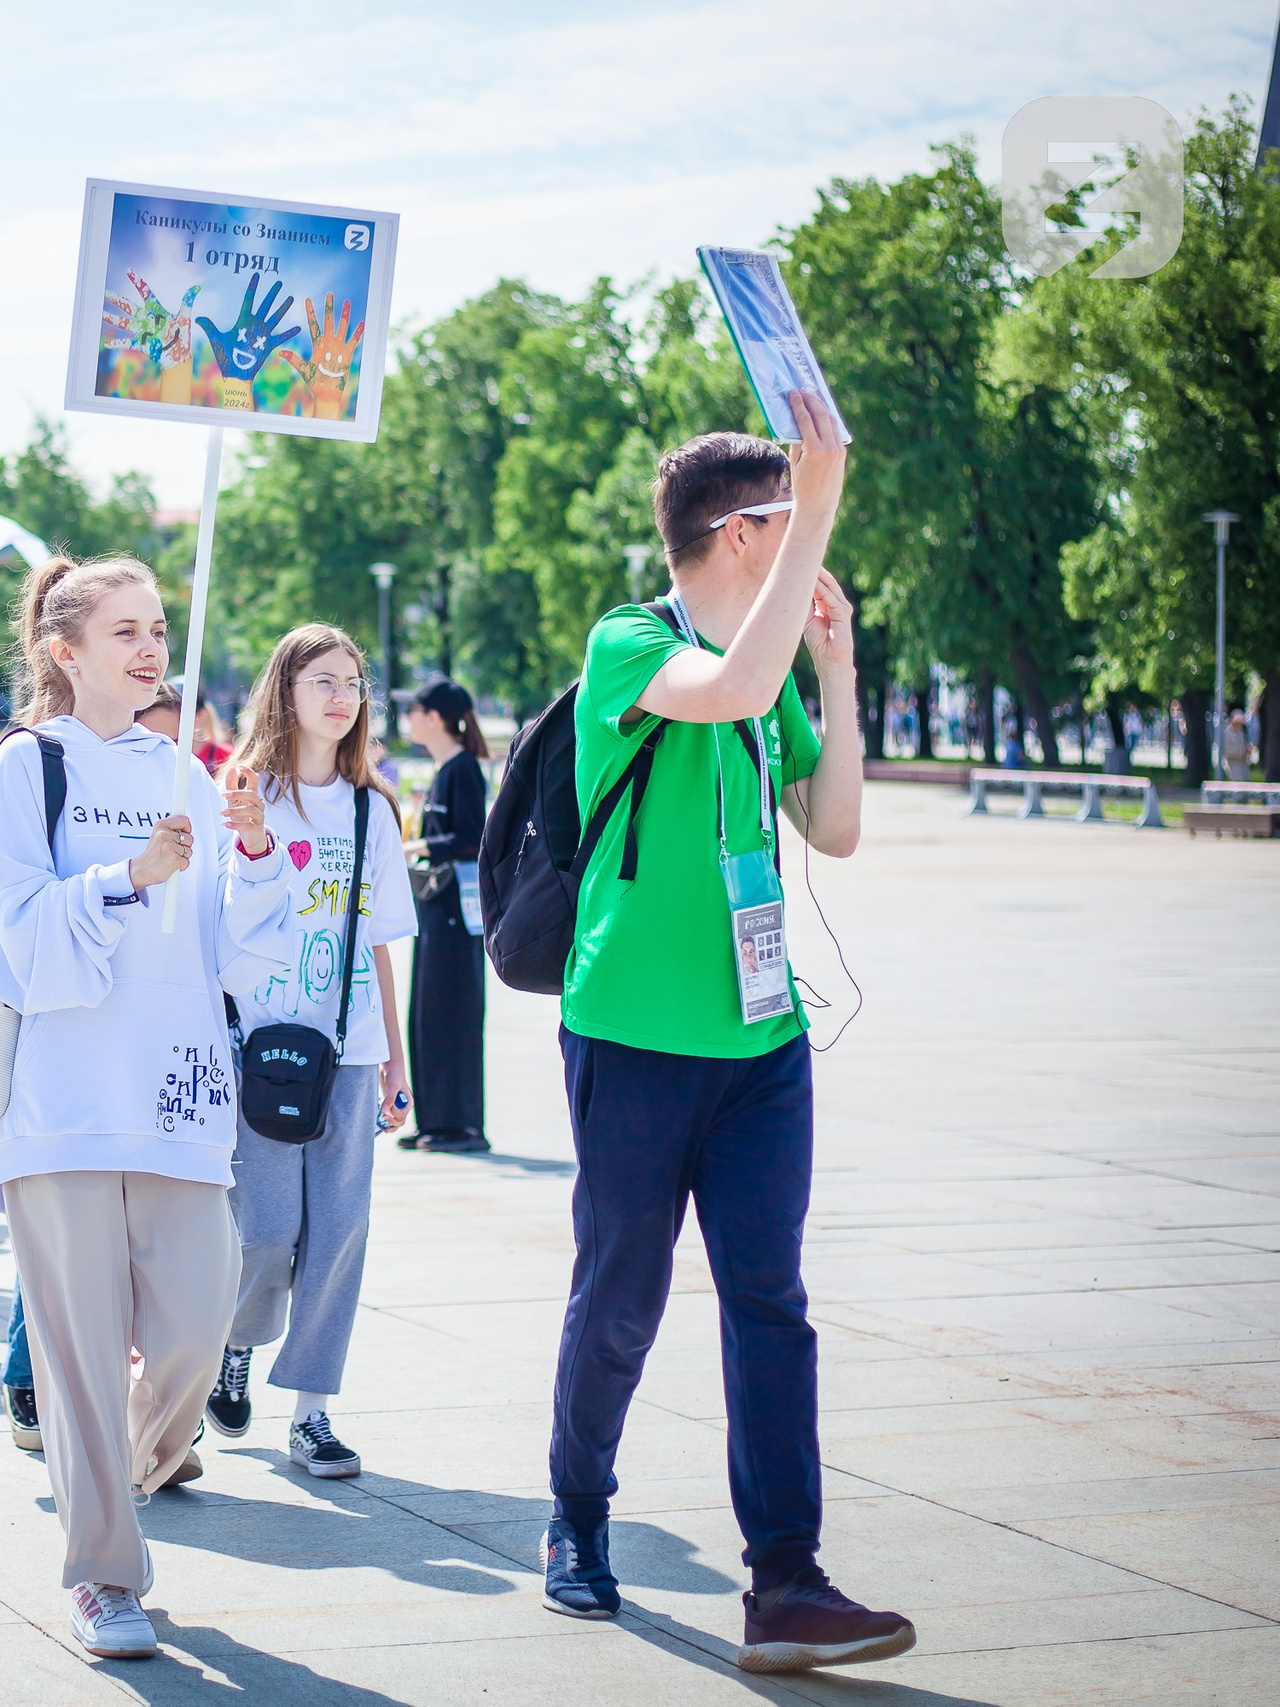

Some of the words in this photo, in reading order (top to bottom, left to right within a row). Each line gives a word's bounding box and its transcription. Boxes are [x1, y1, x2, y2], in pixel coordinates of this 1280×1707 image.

[135, 209, 227, 235] Каникулы
[233, 224, 250, 237] со
[256, 223, 331, 246] Знанием
[186, 241, 195, 263] 1
[206, 249, 280, 275] отряд
[745, 915, 775, 930] РОССИЯ
[261, 1049, 308, 1067] HELLO
